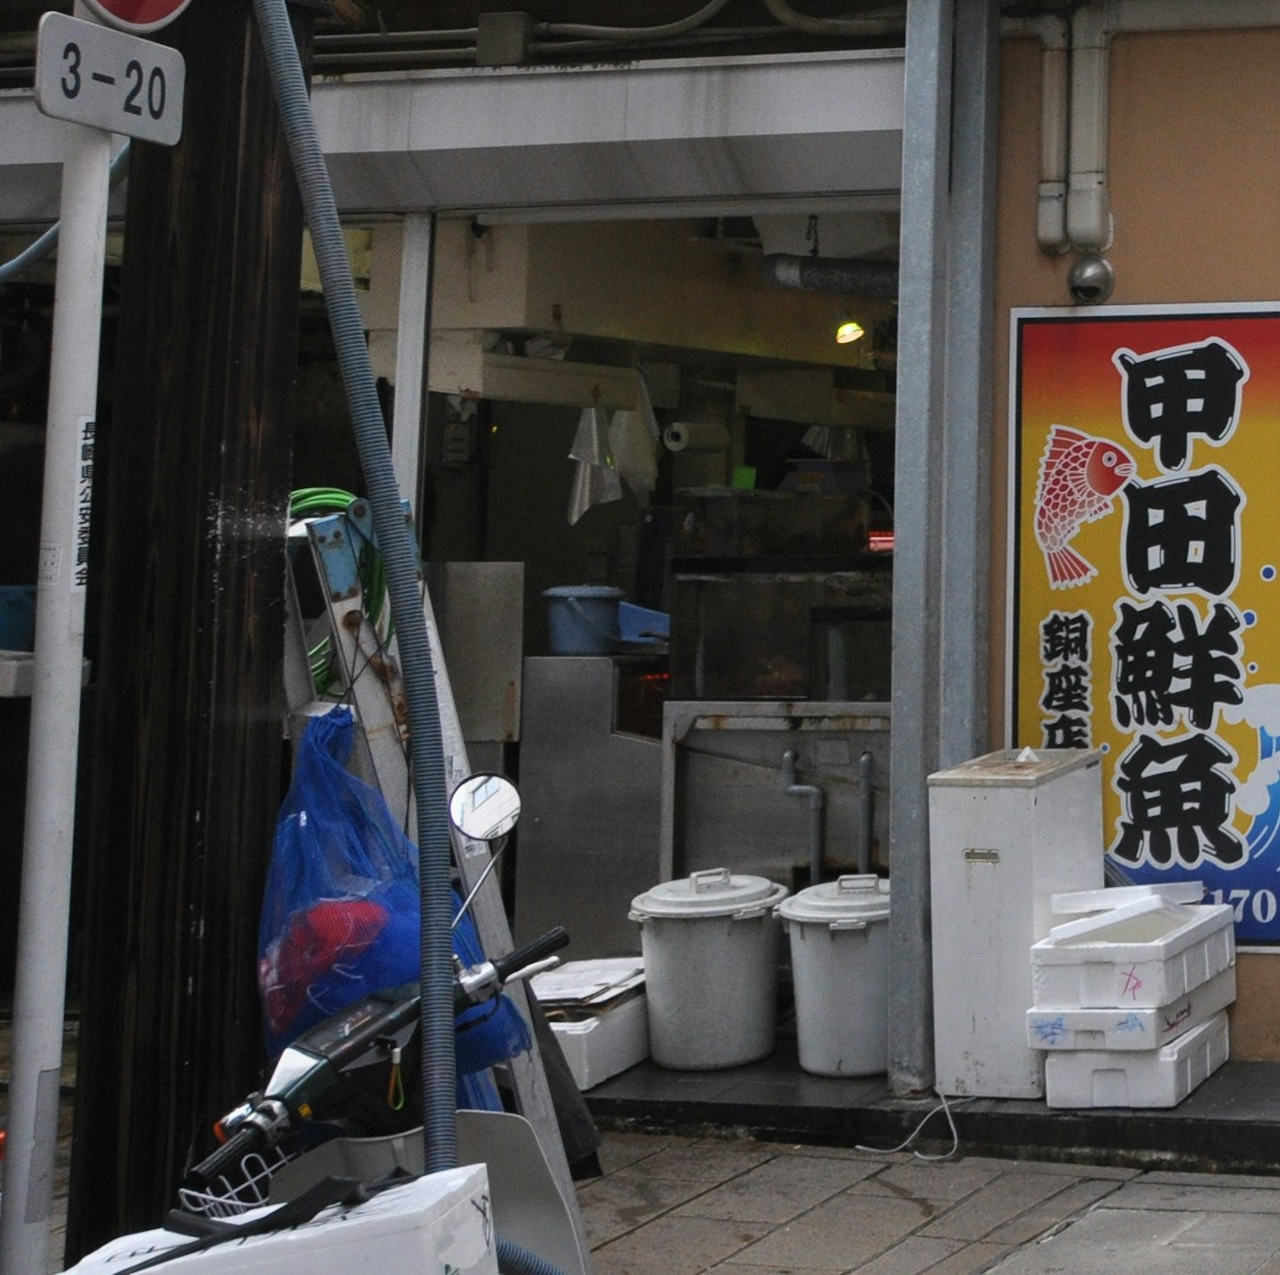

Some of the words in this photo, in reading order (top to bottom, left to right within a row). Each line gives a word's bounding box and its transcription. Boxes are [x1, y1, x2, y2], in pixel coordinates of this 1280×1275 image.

[61, 42, 166, 120] 3-20
[1113, 337, 1250, 870] 甲田鮮魚
[1040, 610, 1093, 749] 銅座店
